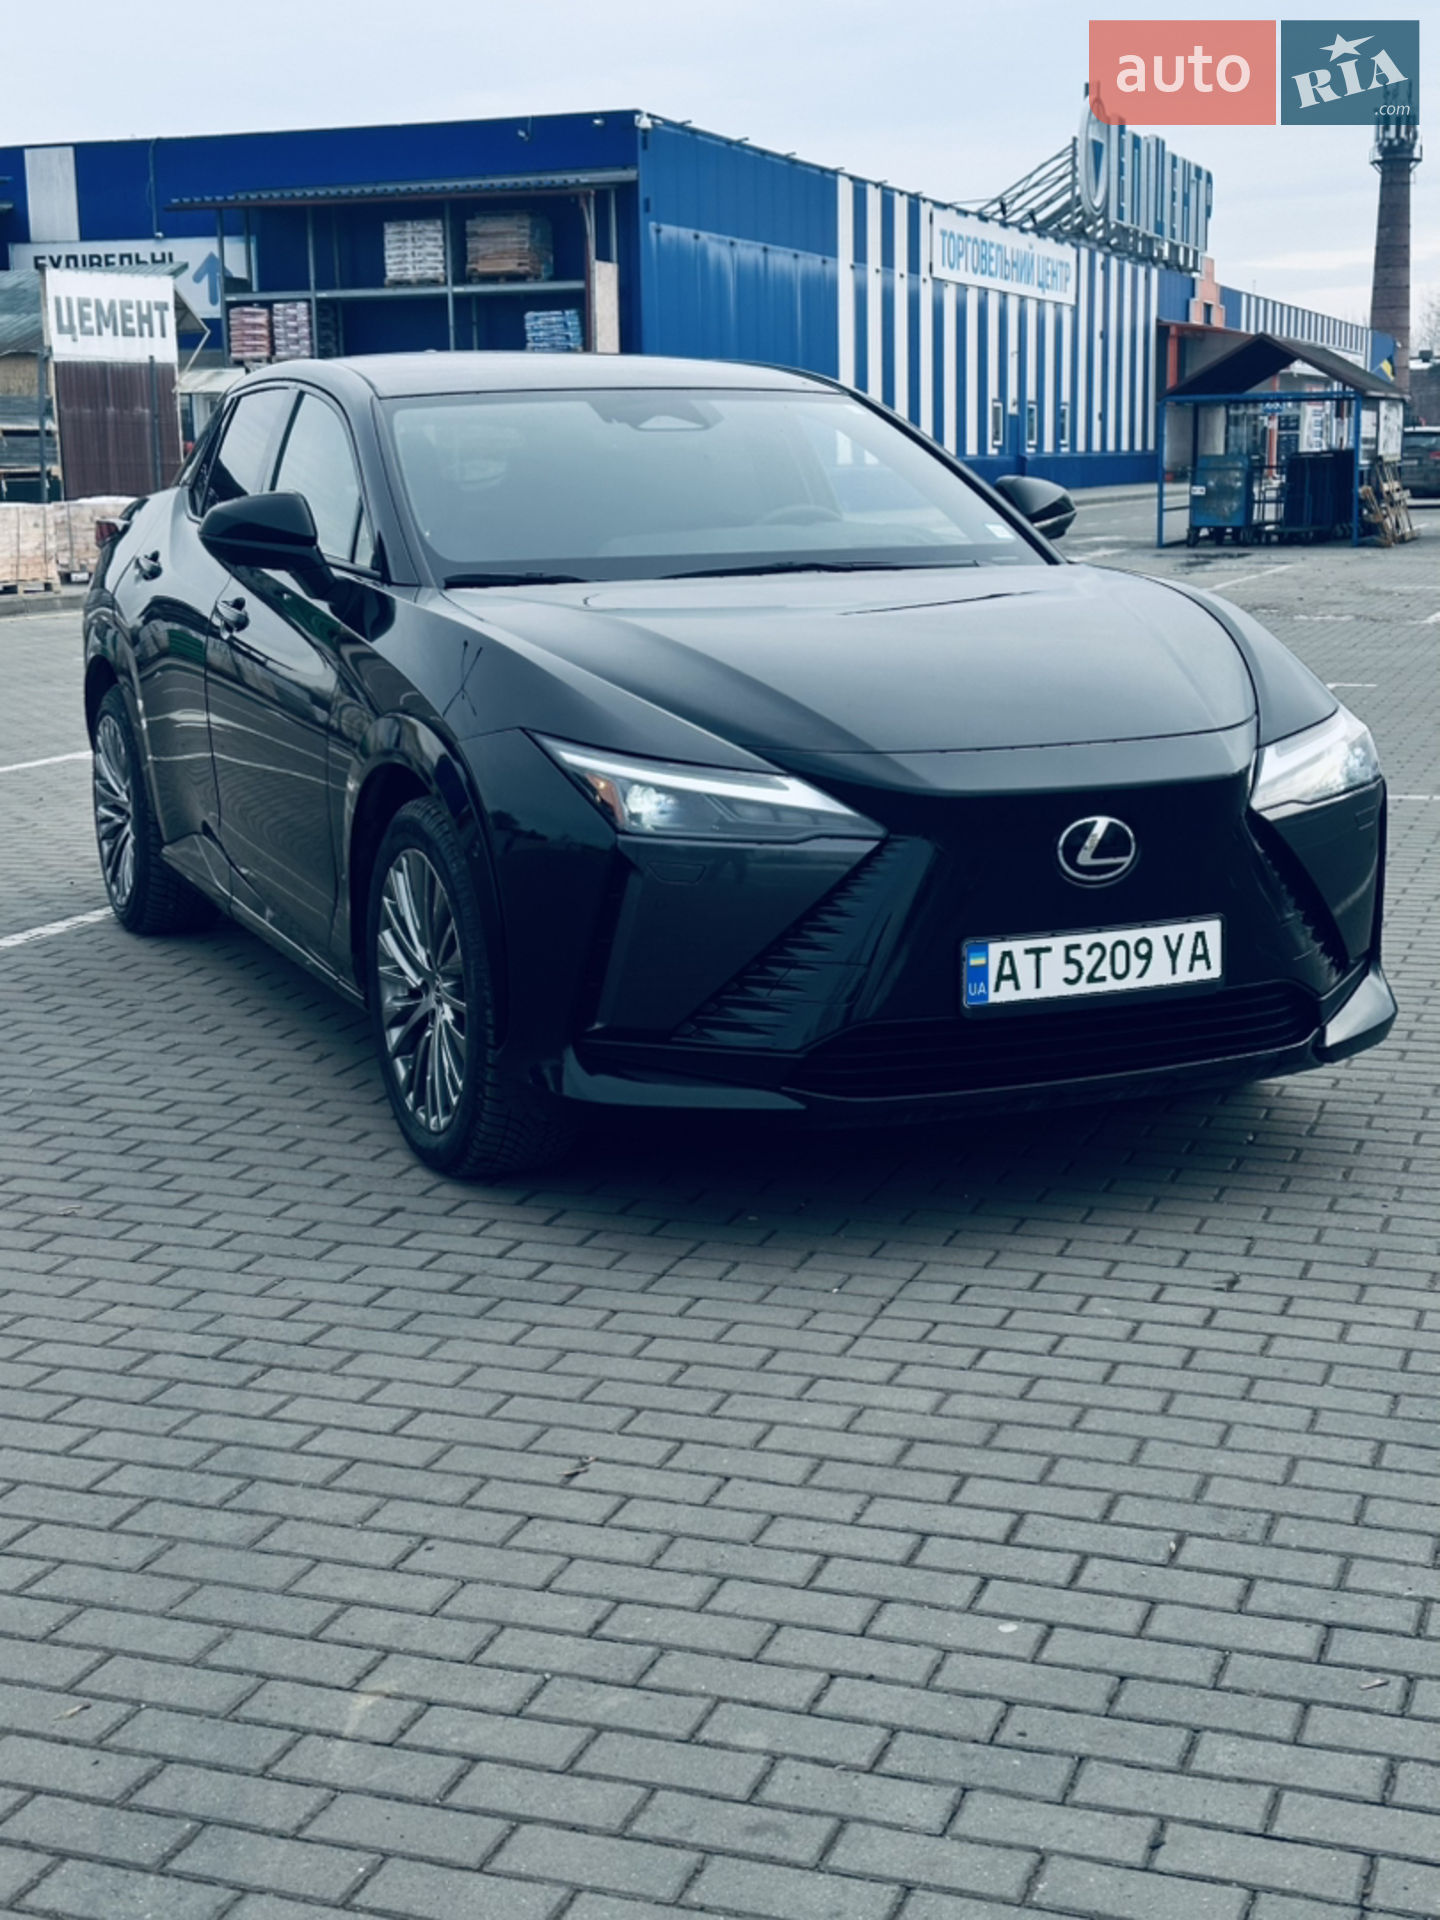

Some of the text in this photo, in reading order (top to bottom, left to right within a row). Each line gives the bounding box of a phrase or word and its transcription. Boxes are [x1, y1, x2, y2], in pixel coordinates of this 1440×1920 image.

[940, 228, 1072, 294] ТОРГОВЕЛЬНИЙ ЦЕНТР
[54, 296, 169, 342] ЦЕМЕНТ
[993, 930, 1212, 993] AT 5209 YA
[968, 982, 987, 996] UA
